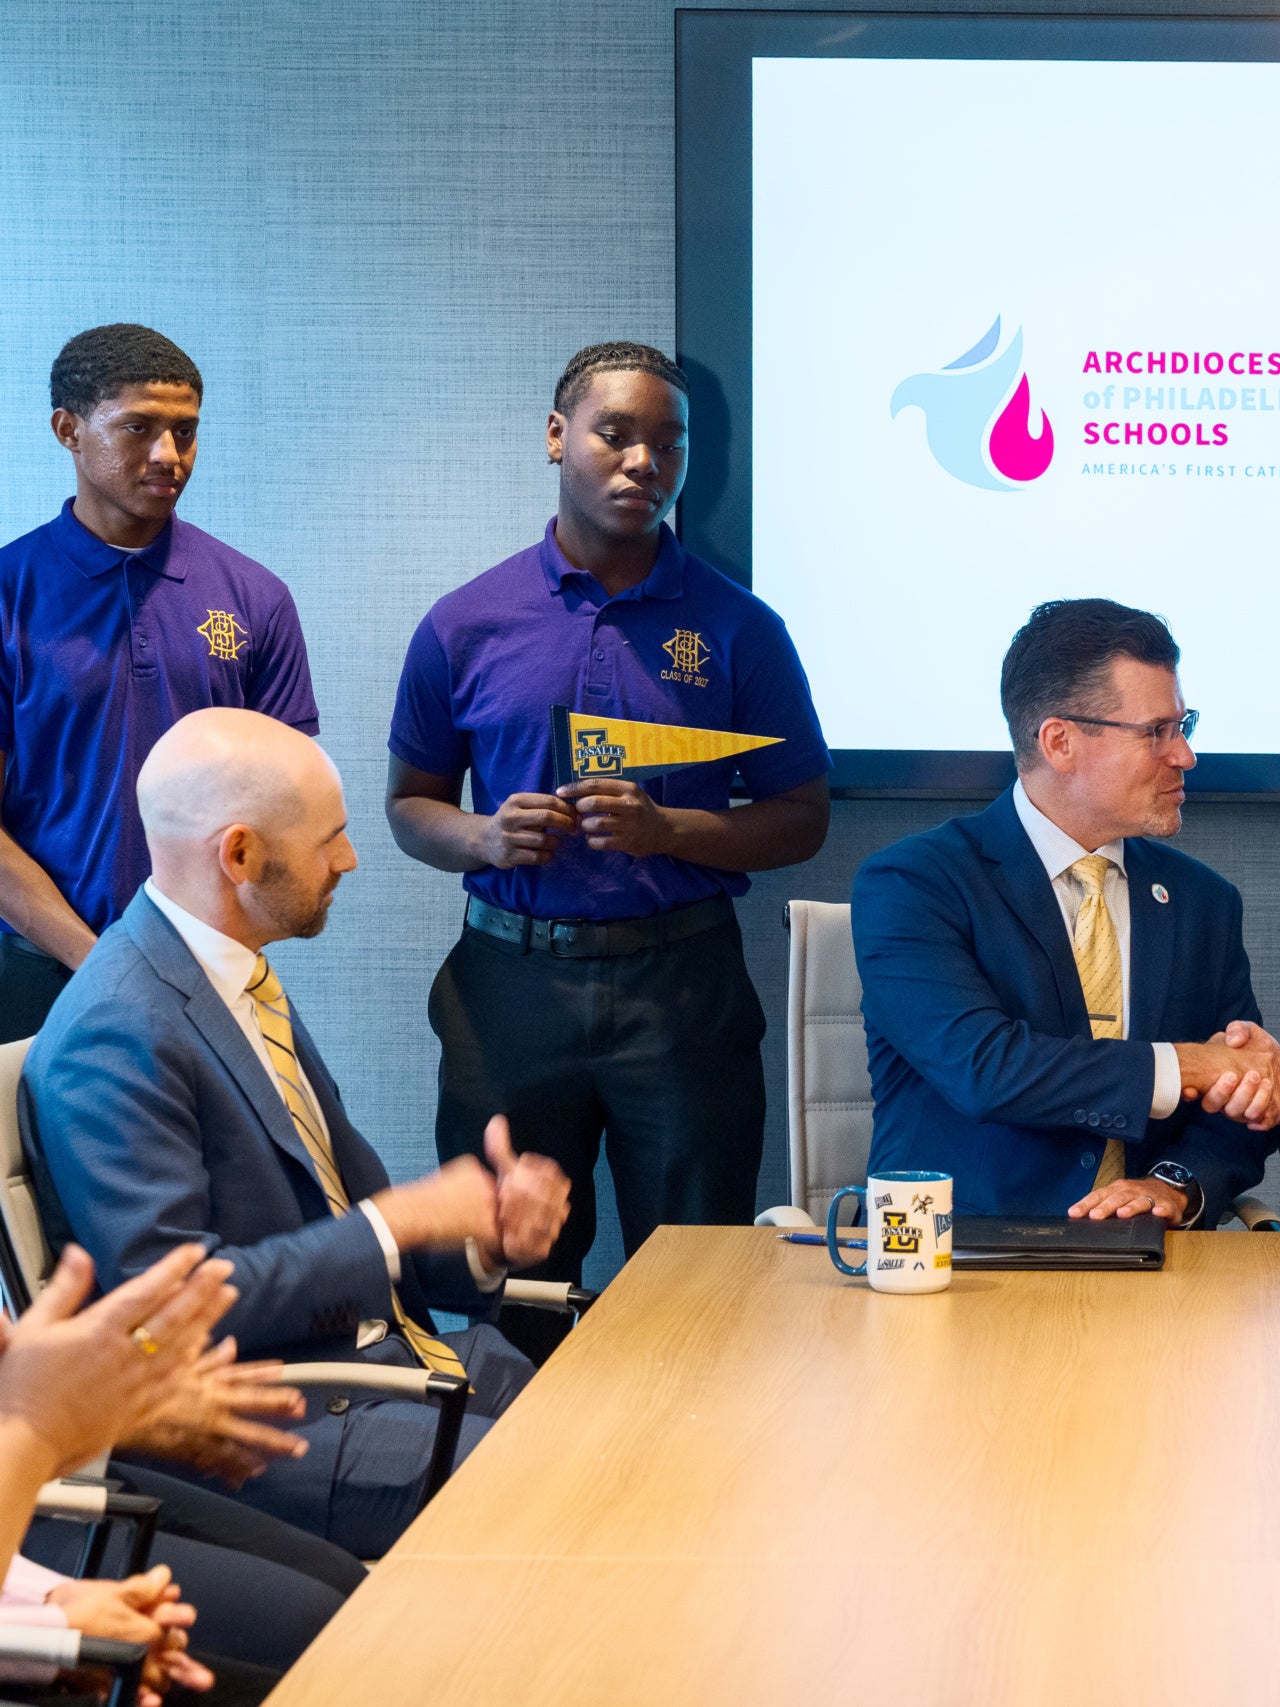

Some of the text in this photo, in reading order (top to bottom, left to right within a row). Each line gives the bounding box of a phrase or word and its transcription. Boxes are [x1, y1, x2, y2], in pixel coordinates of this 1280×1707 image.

[1083, 385, 1115, 410] of
[1083, 421, 1229, 447] SCHOOLS
[1082, 463, 1177, 476] AMERICA'S
[1186, 464, 1237, 478] FIRST
[660, 669, 682, 682] CLASS
[683, 673, 693, 684] OF
